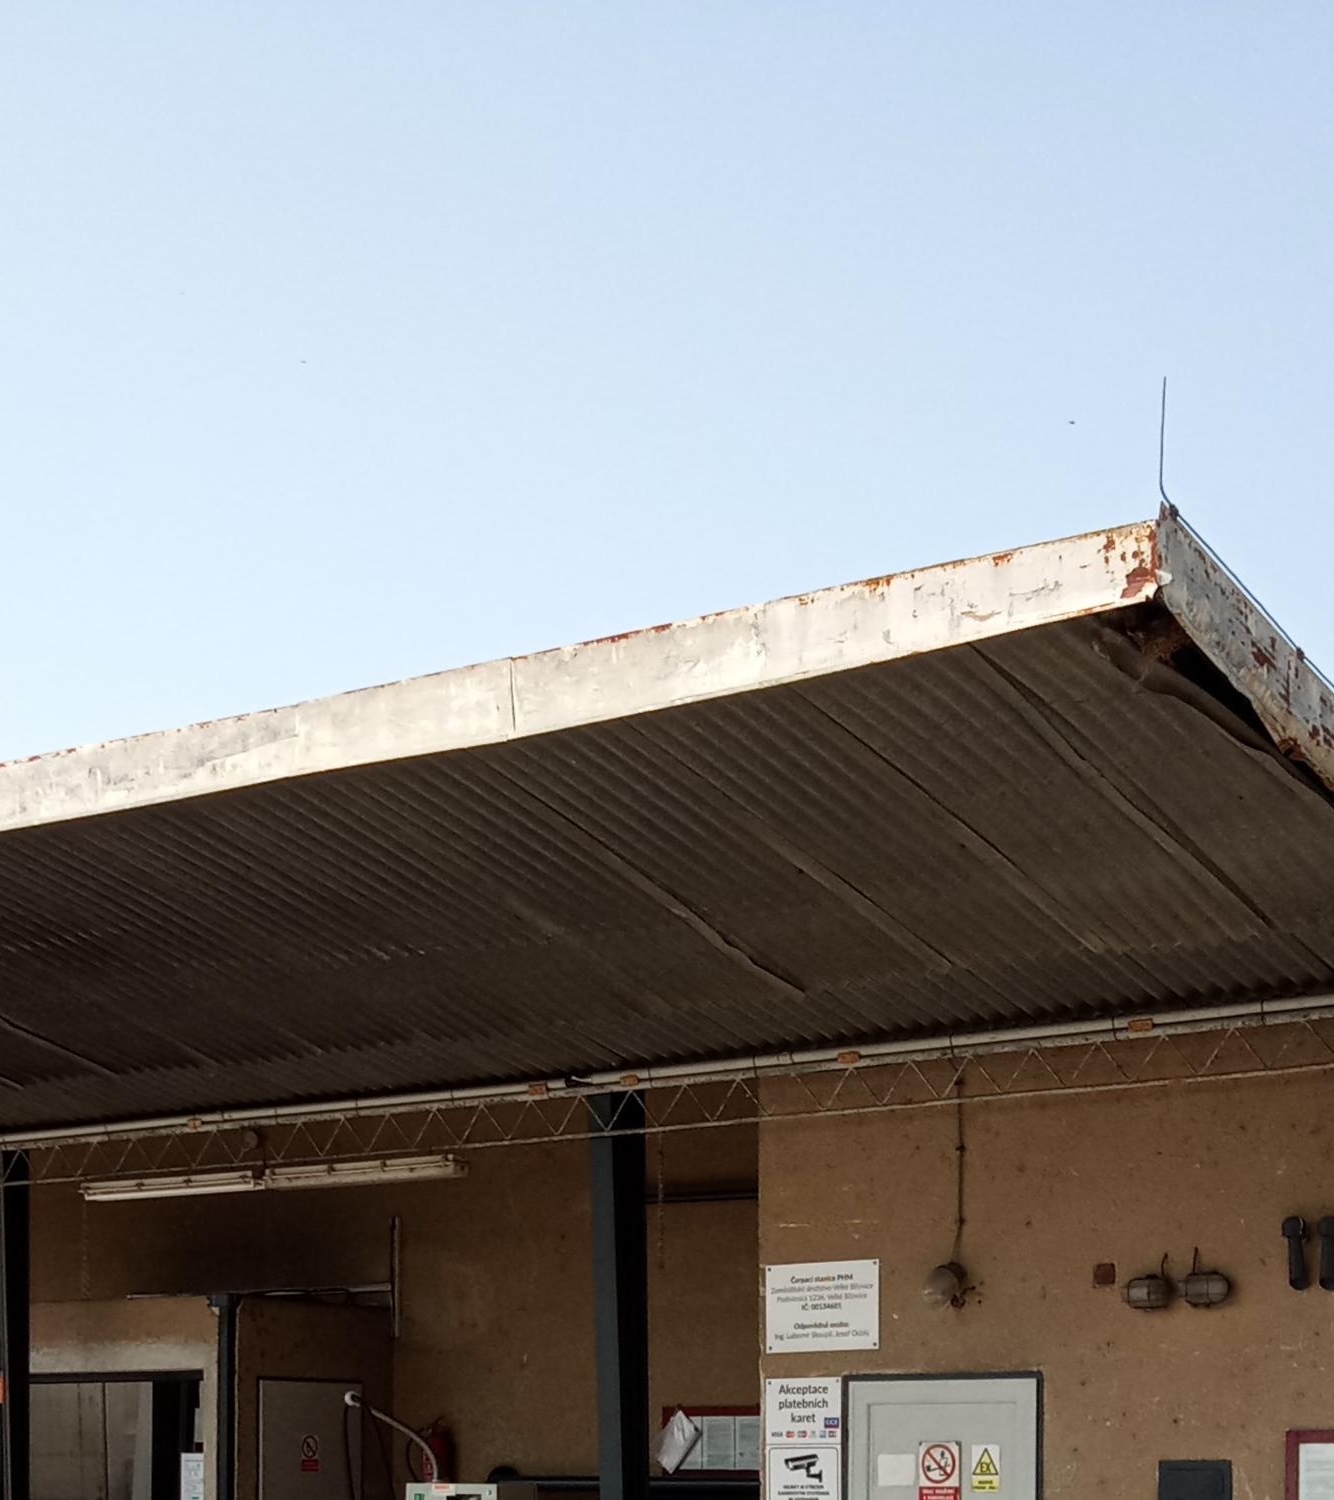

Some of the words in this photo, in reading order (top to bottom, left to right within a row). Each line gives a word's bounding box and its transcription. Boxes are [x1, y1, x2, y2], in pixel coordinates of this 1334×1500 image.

[778, 1383, 829, 1396] Akceptace
[790, 1412, 816, 1423] karet
[979, 1462, 991, 1473] EX
